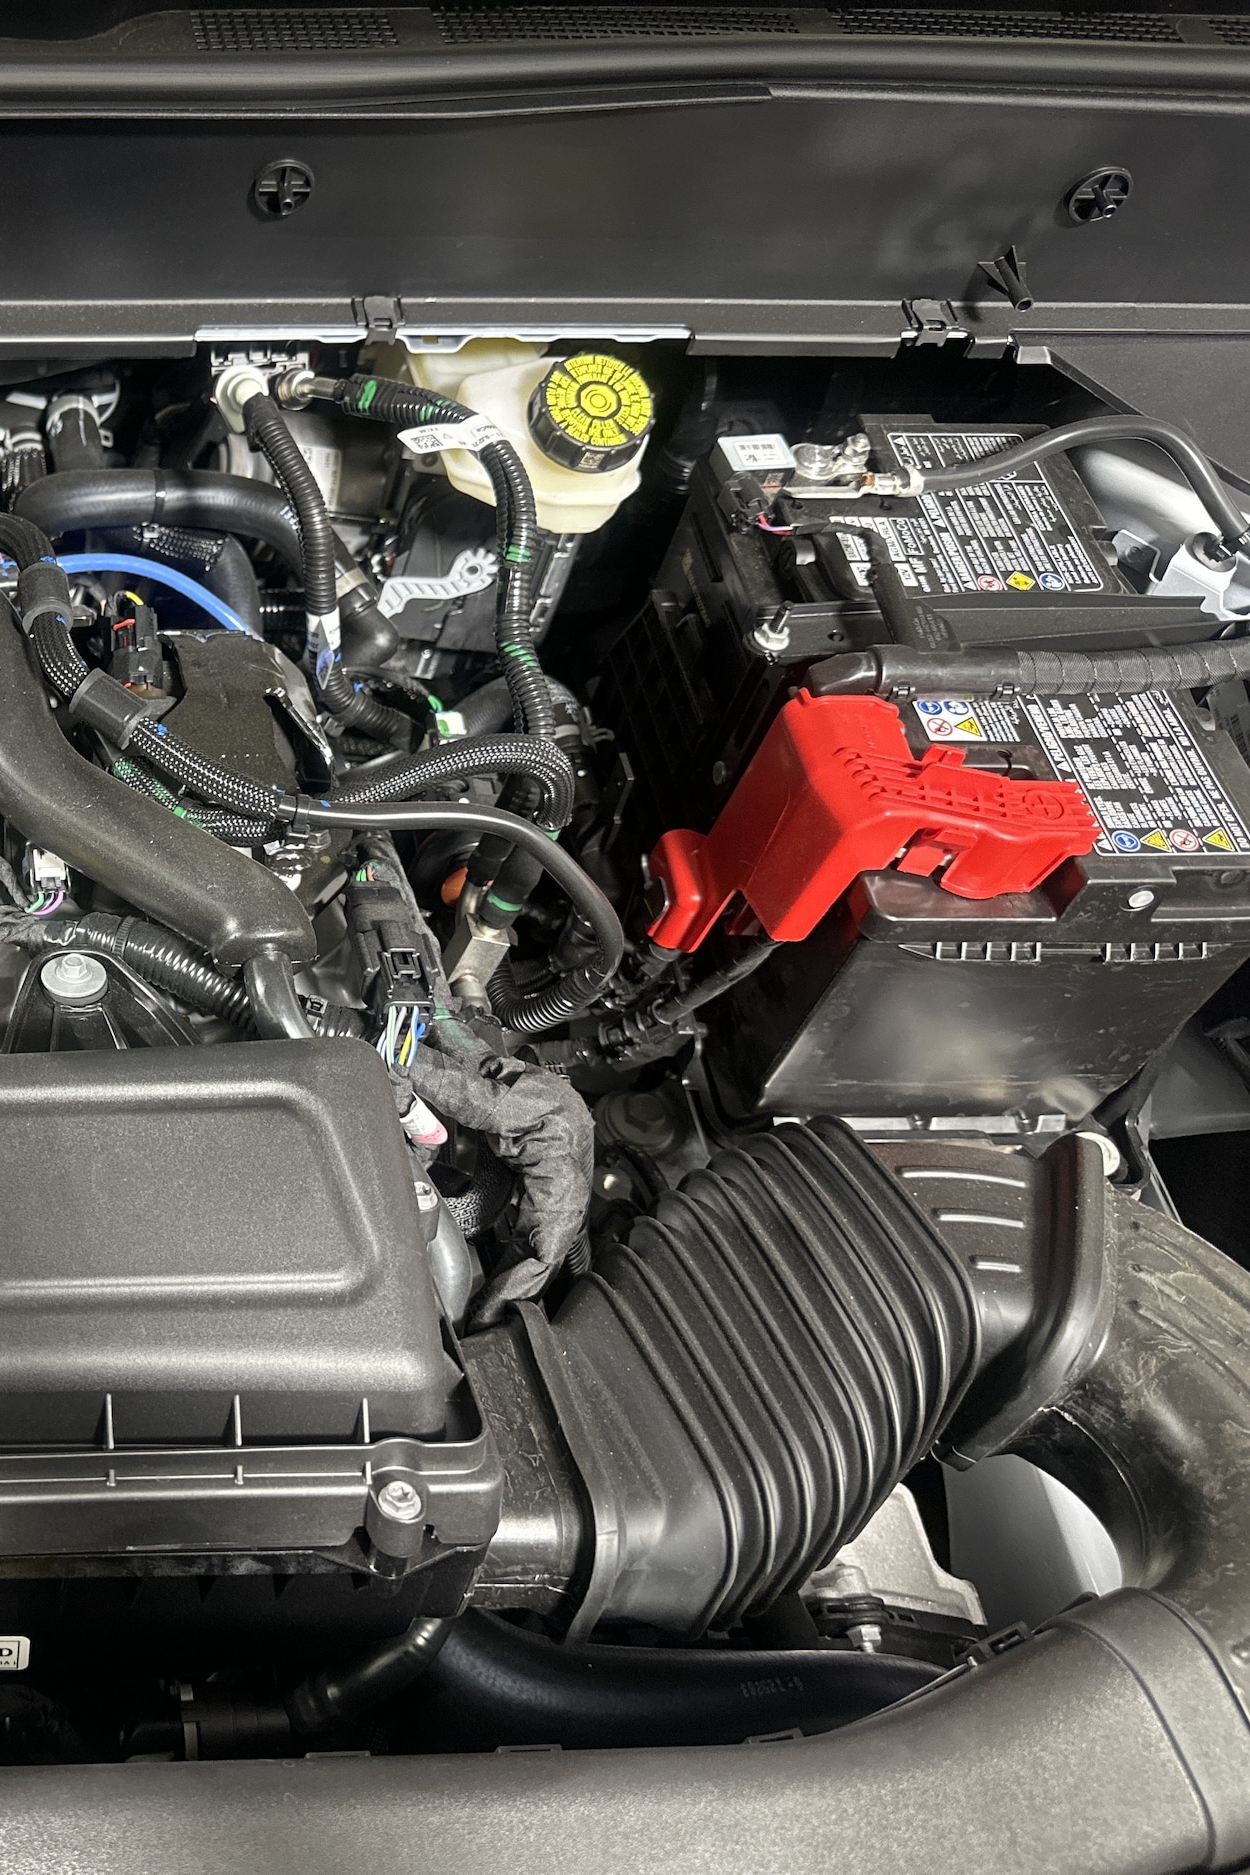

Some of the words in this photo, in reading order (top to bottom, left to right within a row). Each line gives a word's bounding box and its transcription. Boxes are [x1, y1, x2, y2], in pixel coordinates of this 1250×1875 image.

[893, 520, 921, 553] FoMoCo
[909, 558, 928, 573] MF
[901, 569, 912, 580] 12V
[1026, 705, 1067, 761] PELIGRO/VENENO
[1200, 777, 1216, 789] PAS
[1227, 823, 1244, 836] NOT
[1236, 838, 1250, 848] DO
